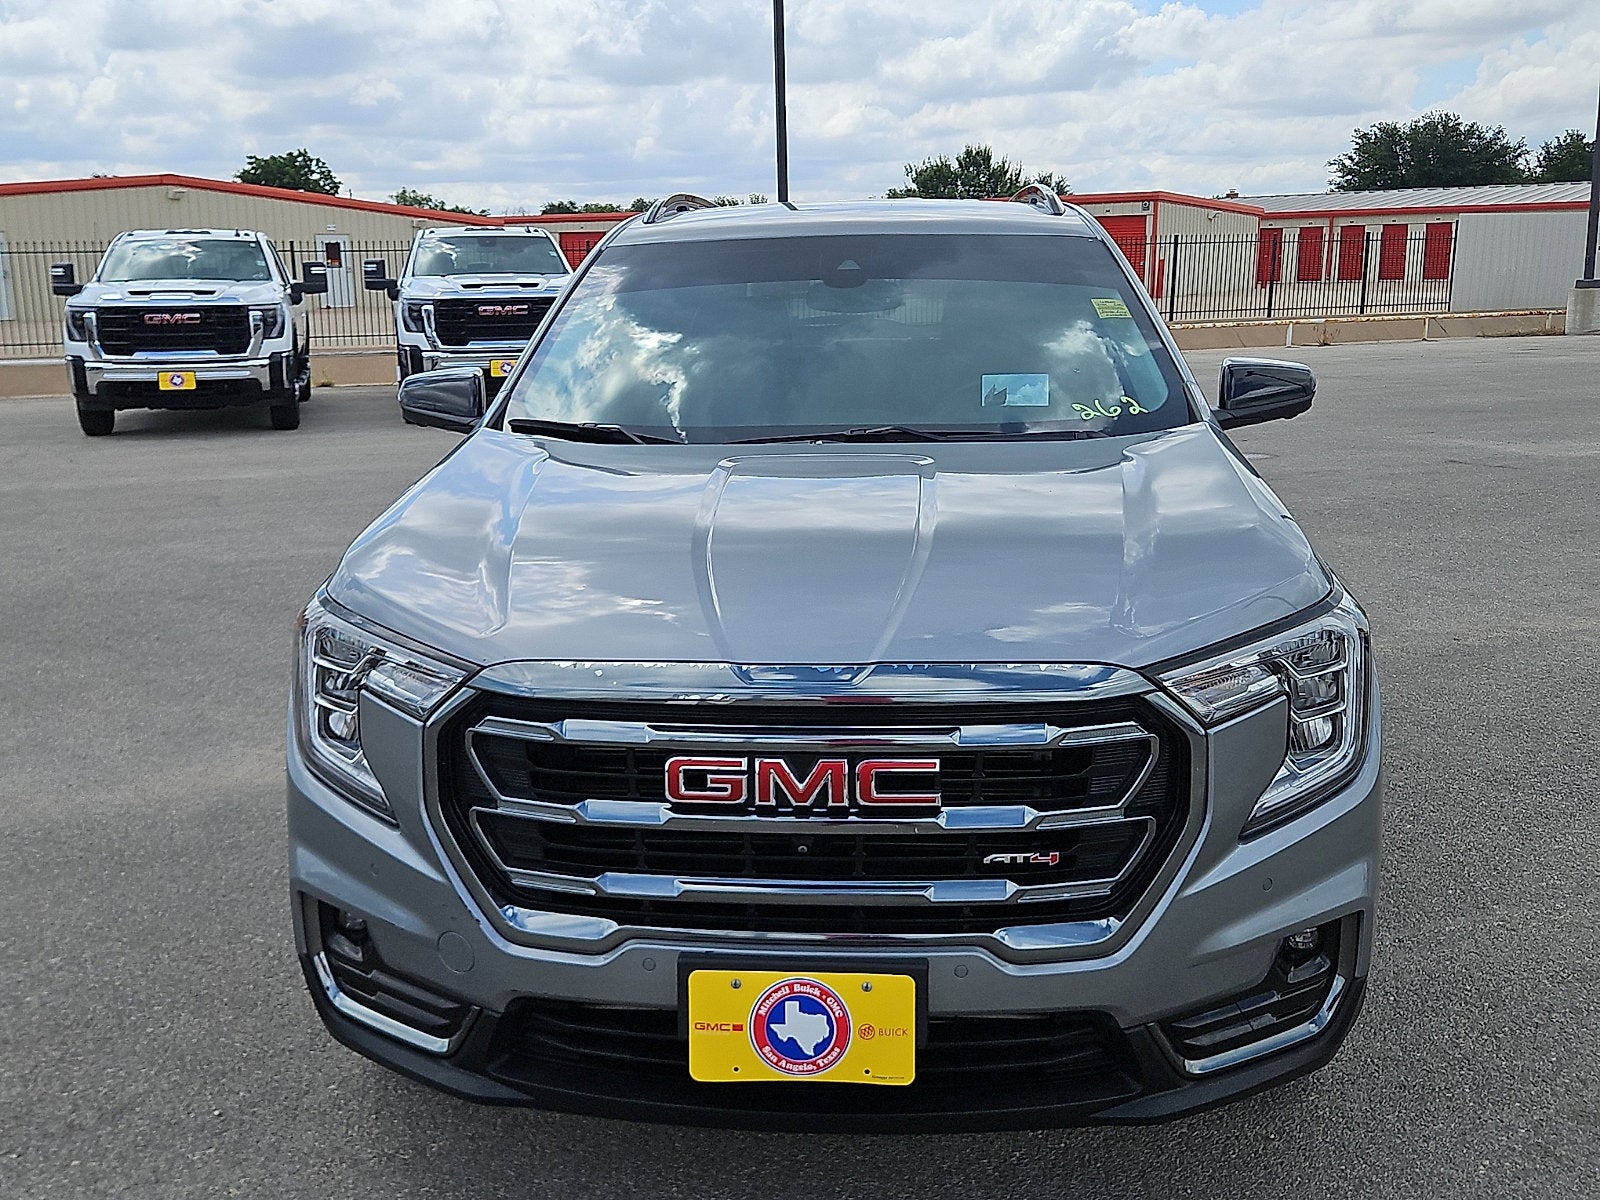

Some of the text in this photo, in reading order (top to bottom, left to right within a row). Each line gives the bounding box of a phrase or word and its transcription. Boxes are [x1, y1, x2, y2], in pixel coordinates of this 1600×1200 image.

[478, 305, 528, 315] GMC
[144, 313, 201, 324] GMC
[1071, 395, 1148, 421] 262
[664, 755, 942, 807] GMC
[983, 851, 1060, 866] AT4
[758, 983, 844, 1018] Mitchell Buick GMC
[694, 1022, 731, 1031] GMC
[878, 1027, 909, 1037] BUICK
[762, 1045, 778, 1063] San
[817, 1046, 841, 1067] Texas
